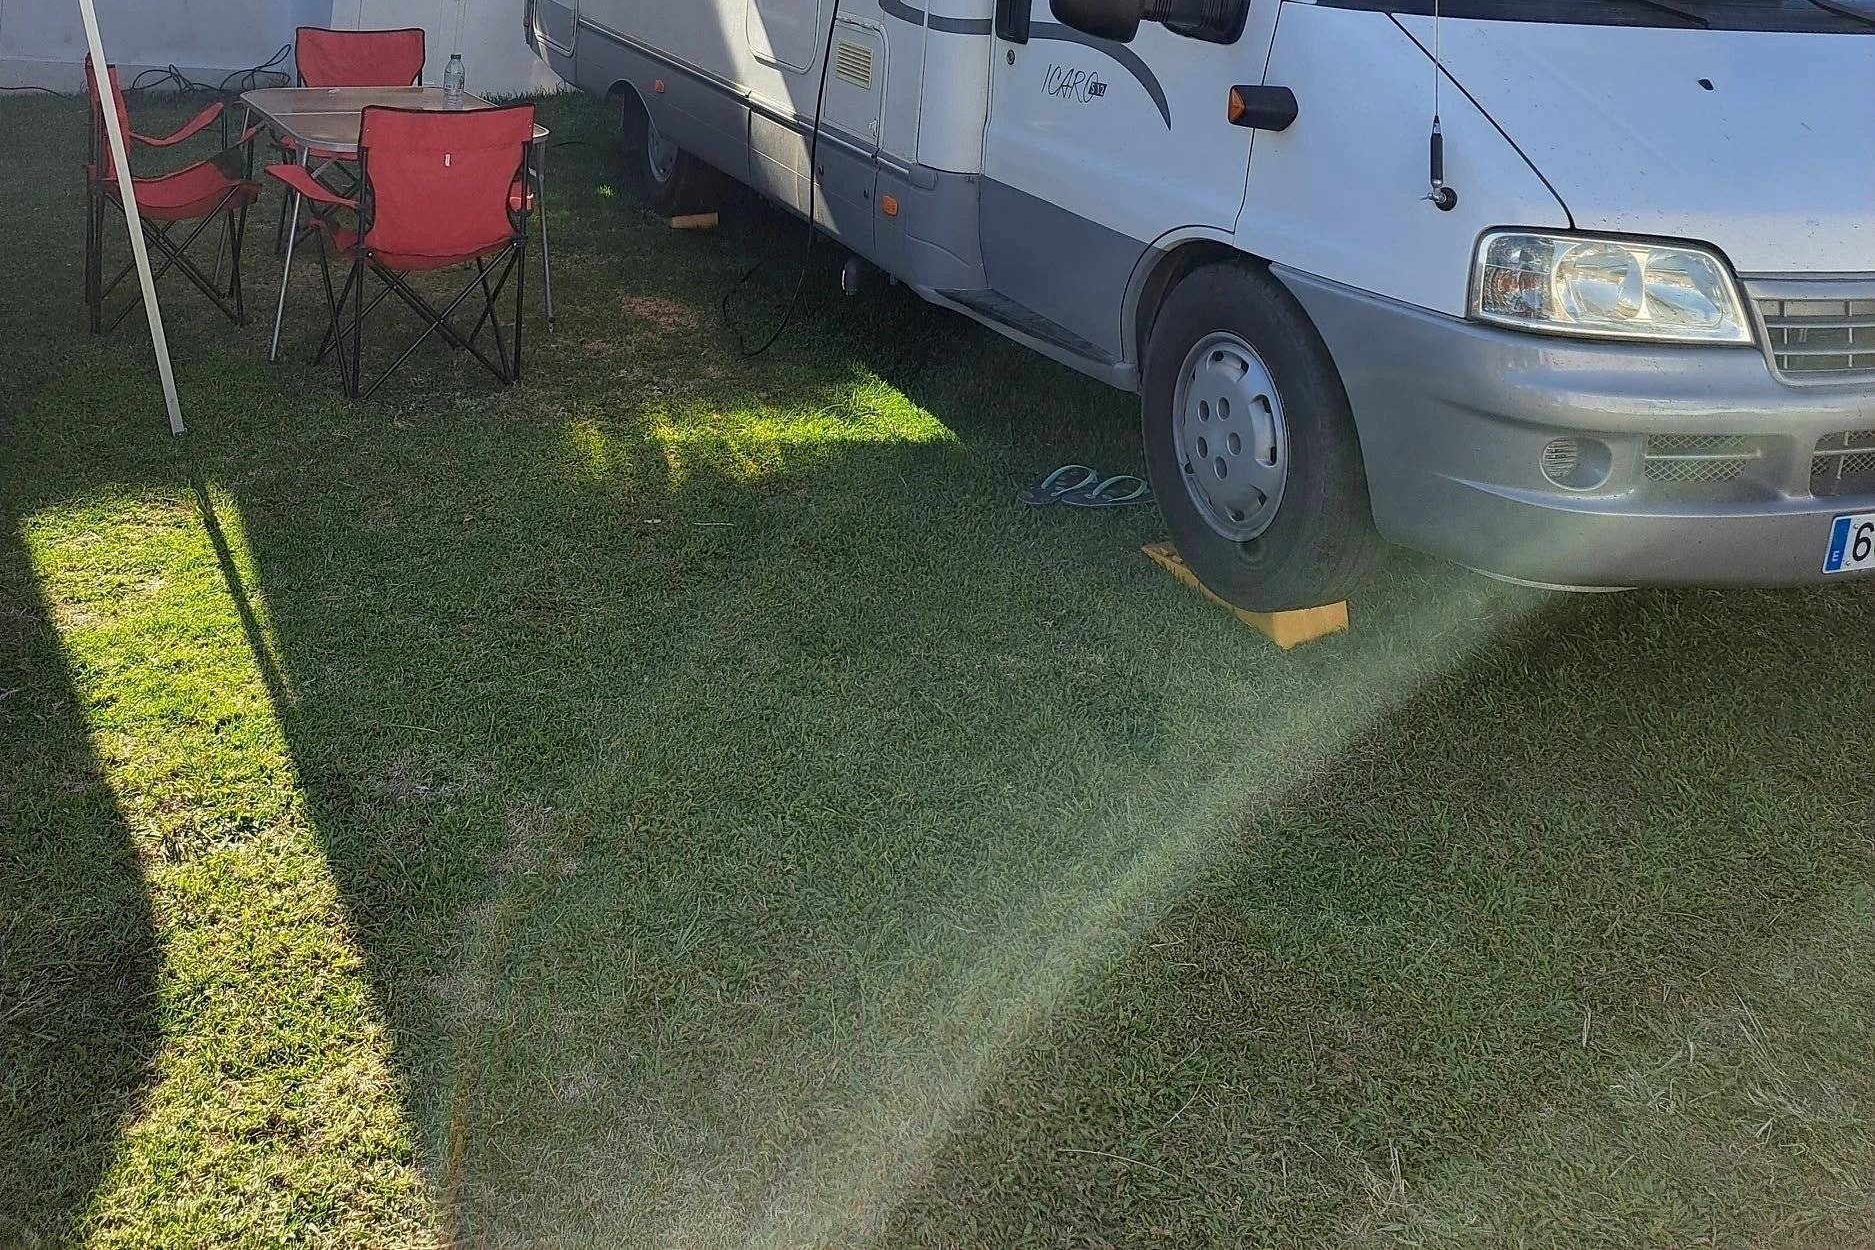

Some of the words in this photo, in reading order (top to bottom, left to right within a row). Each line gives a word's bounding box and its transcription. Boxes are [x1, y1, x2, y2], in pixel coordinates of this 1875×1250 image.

[1041, 64, 1099, 103] ICARO
[1831, 550, 1840, 562] E
[1852, 521, 1875, 562] 6
